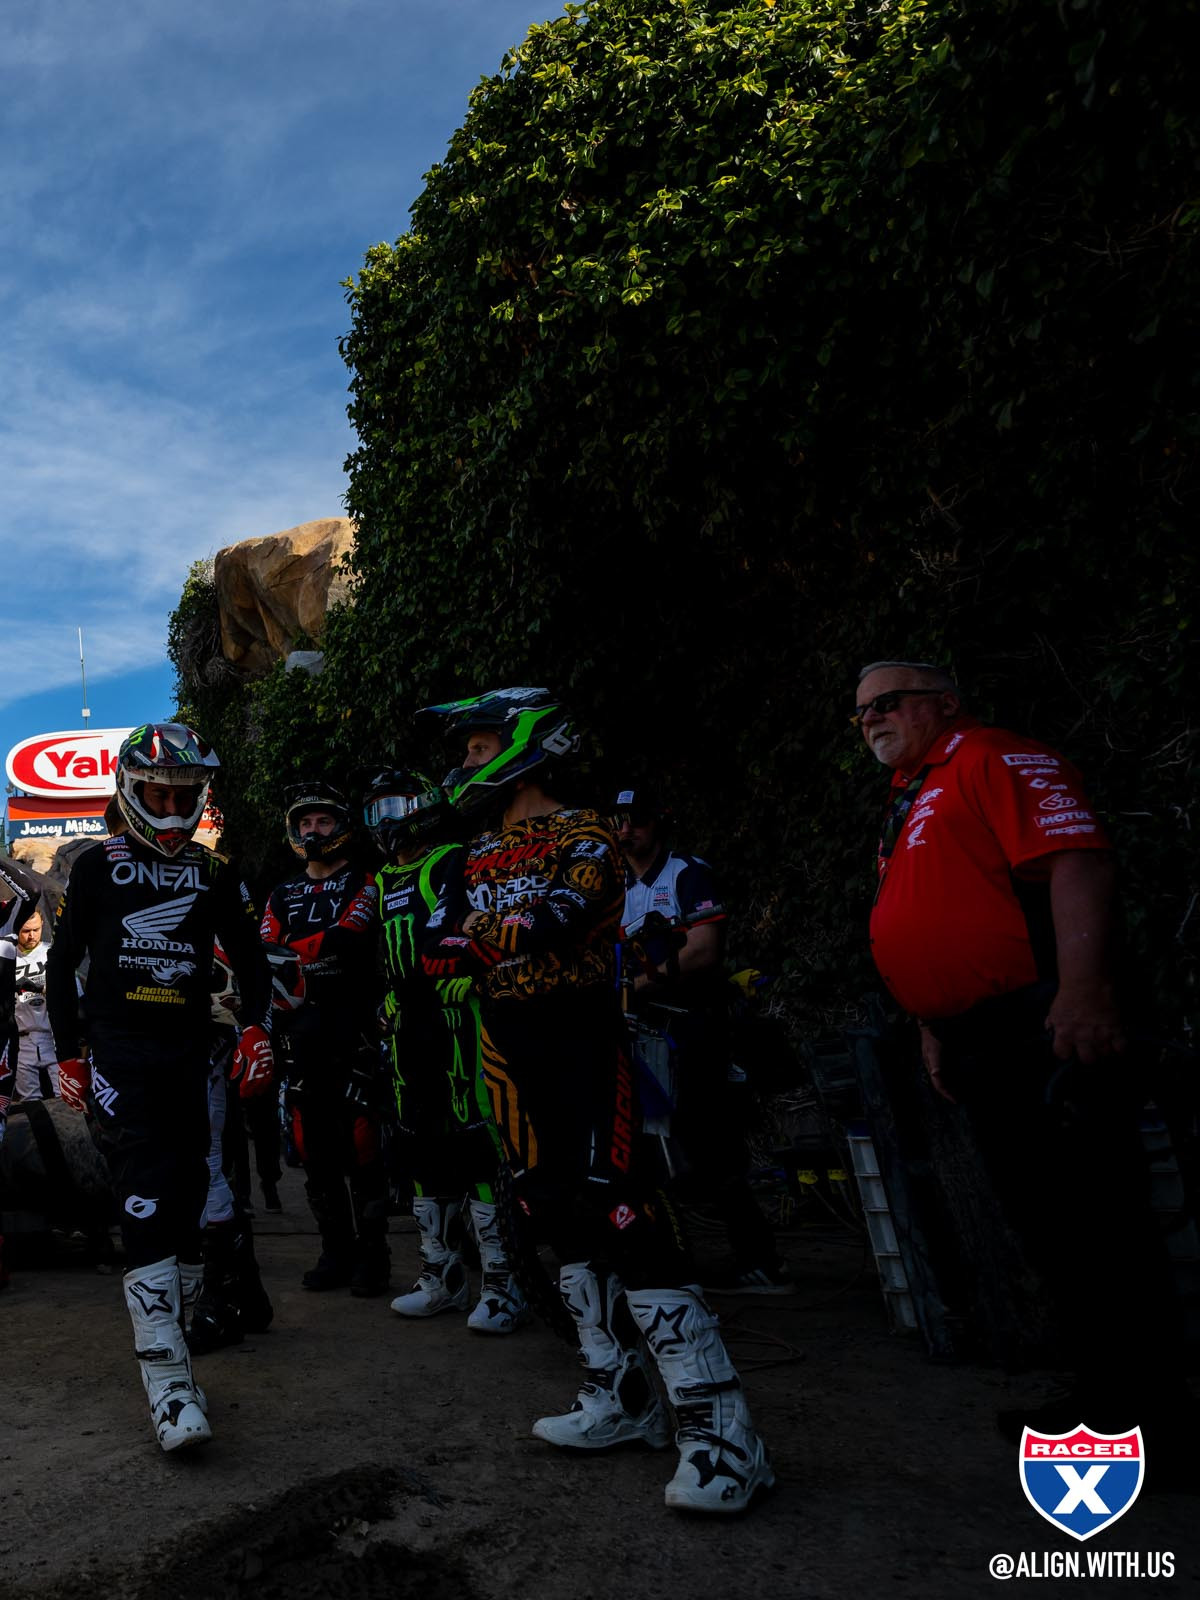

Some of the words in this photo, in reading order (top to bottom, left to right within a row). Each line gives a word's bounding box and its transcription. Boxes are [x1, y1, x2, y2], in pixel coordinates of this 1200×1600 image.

[20, 822, 62, 838] Jersey
[121, 938, 196, 954] HONDA
[119, 955, 177, 968] PHOENIX
